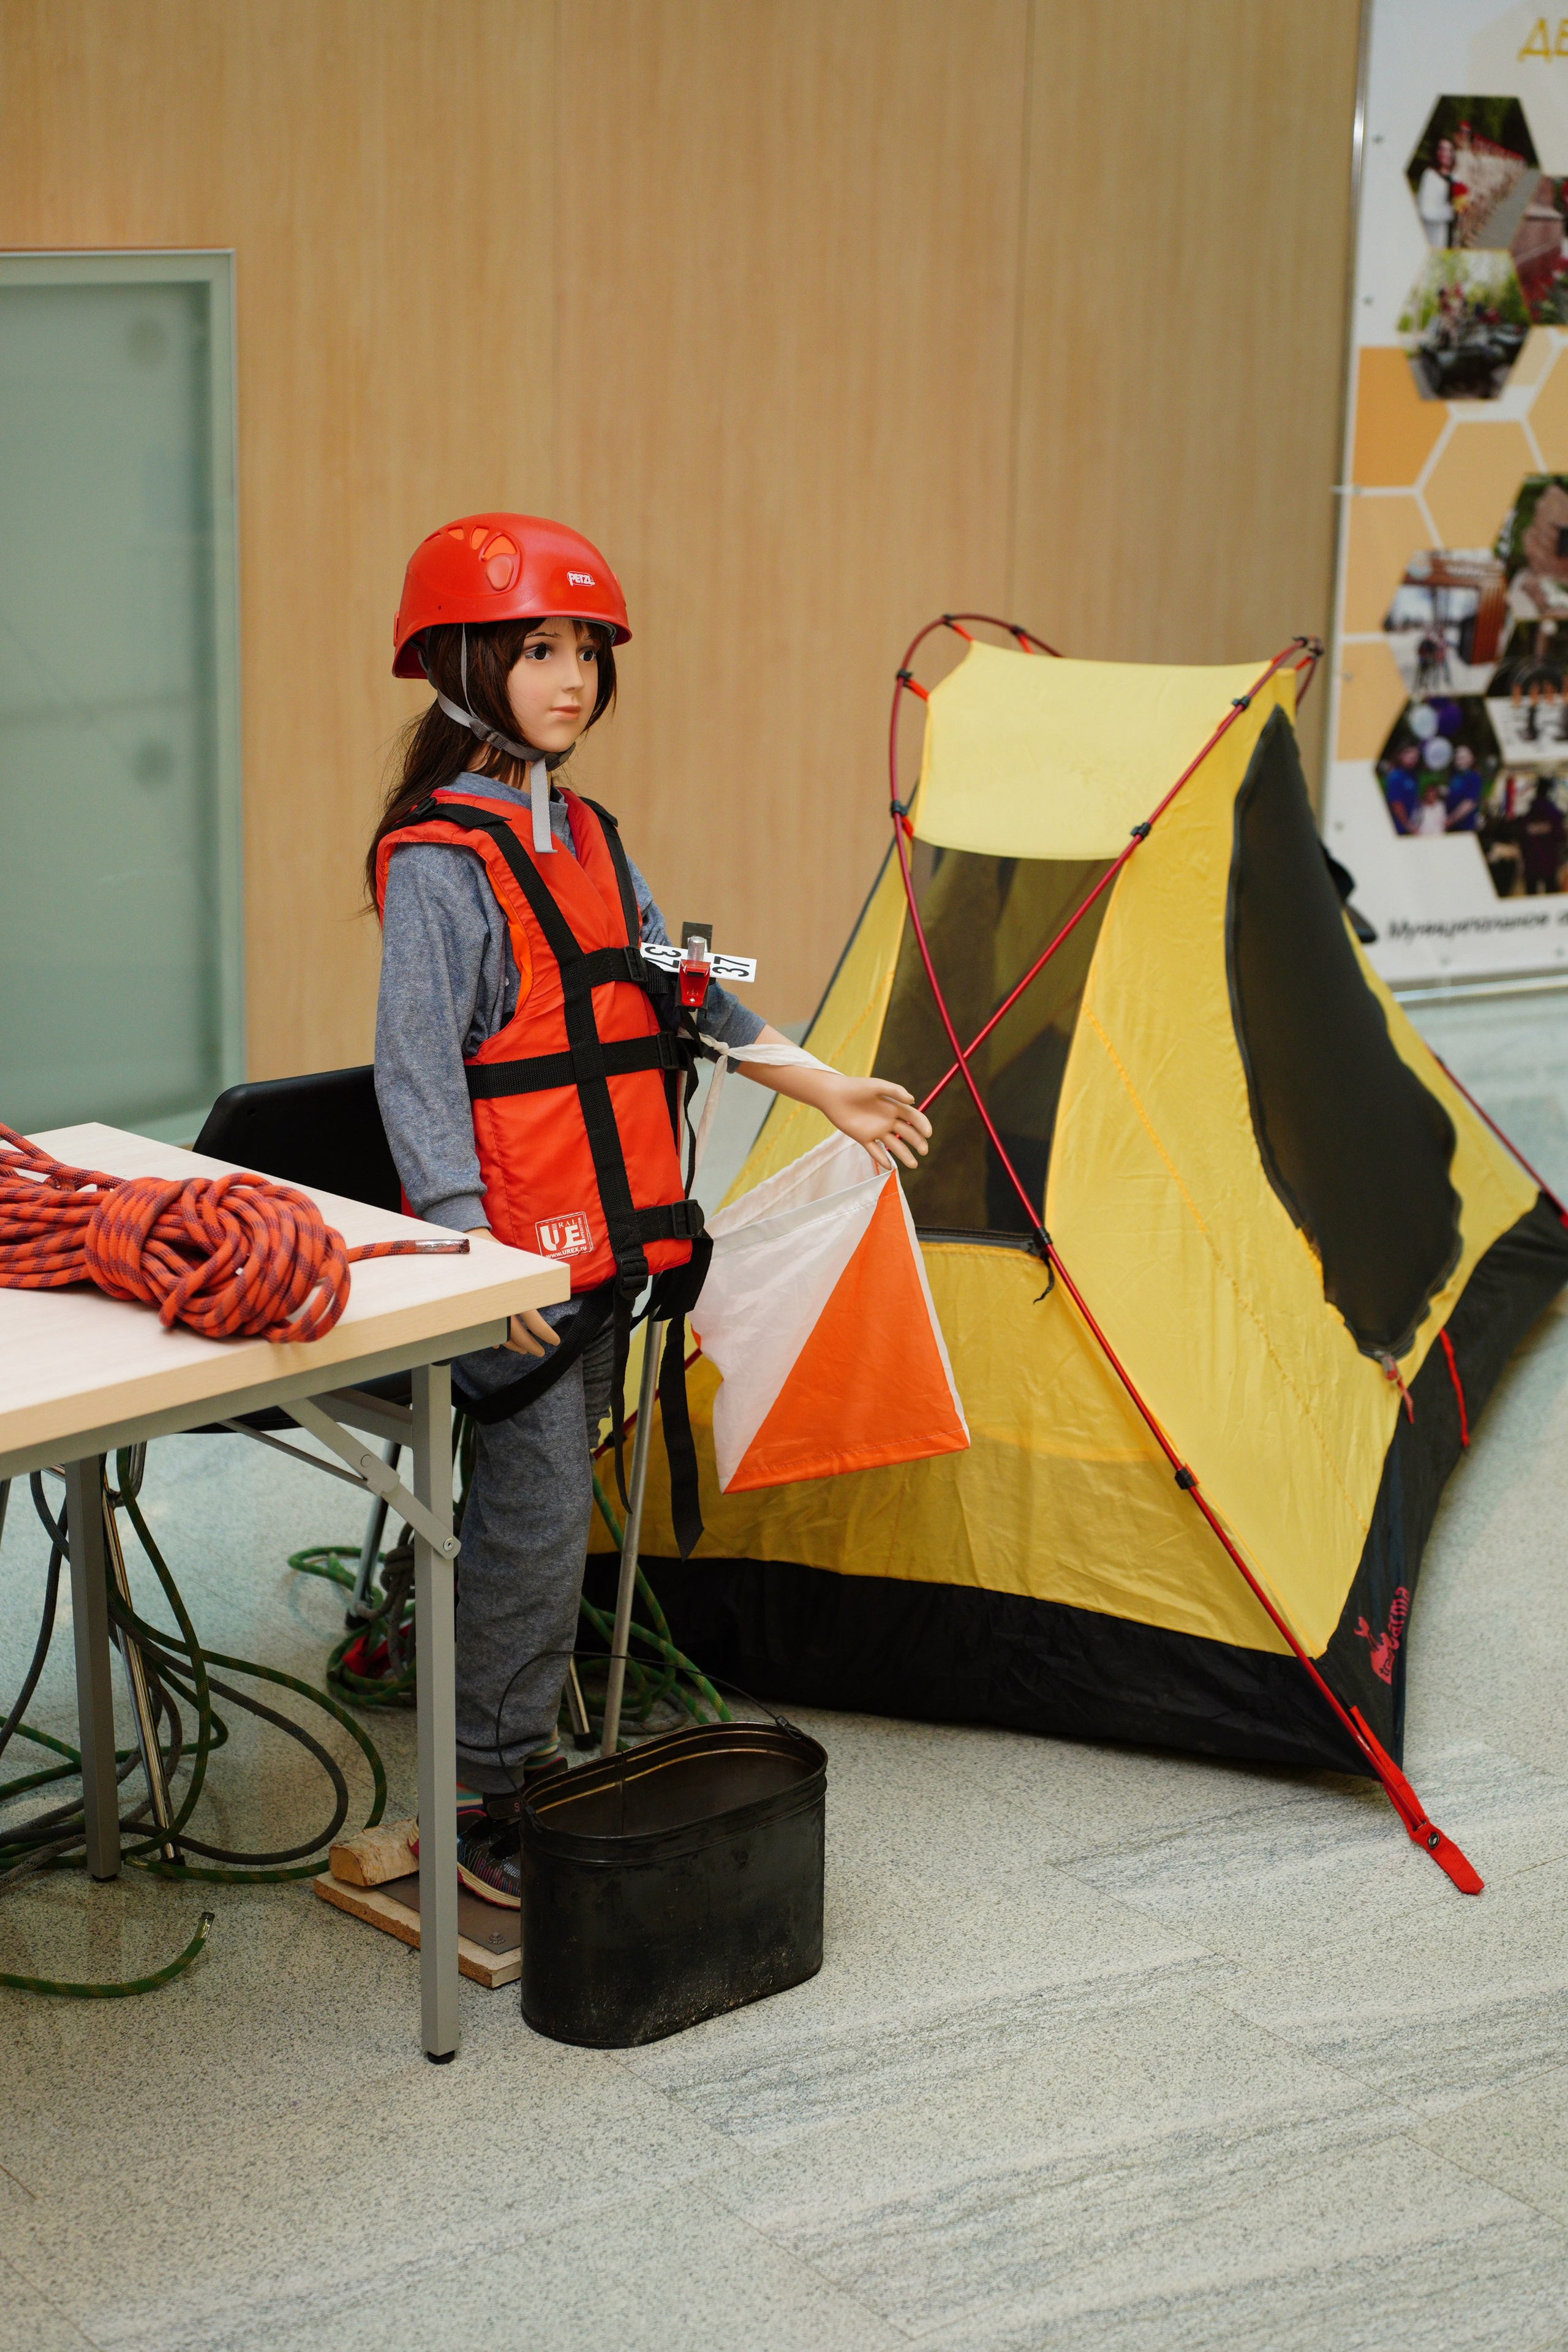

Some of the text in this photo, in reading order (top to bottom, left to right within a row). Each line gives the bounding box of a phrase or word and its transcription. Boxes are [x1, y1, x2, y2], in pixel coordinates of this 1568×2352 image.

[644, 946, 682, 969] 37
[712, 956, 750, 978] 37
[546, 1246, 587, 1259] www.UREX.ru
